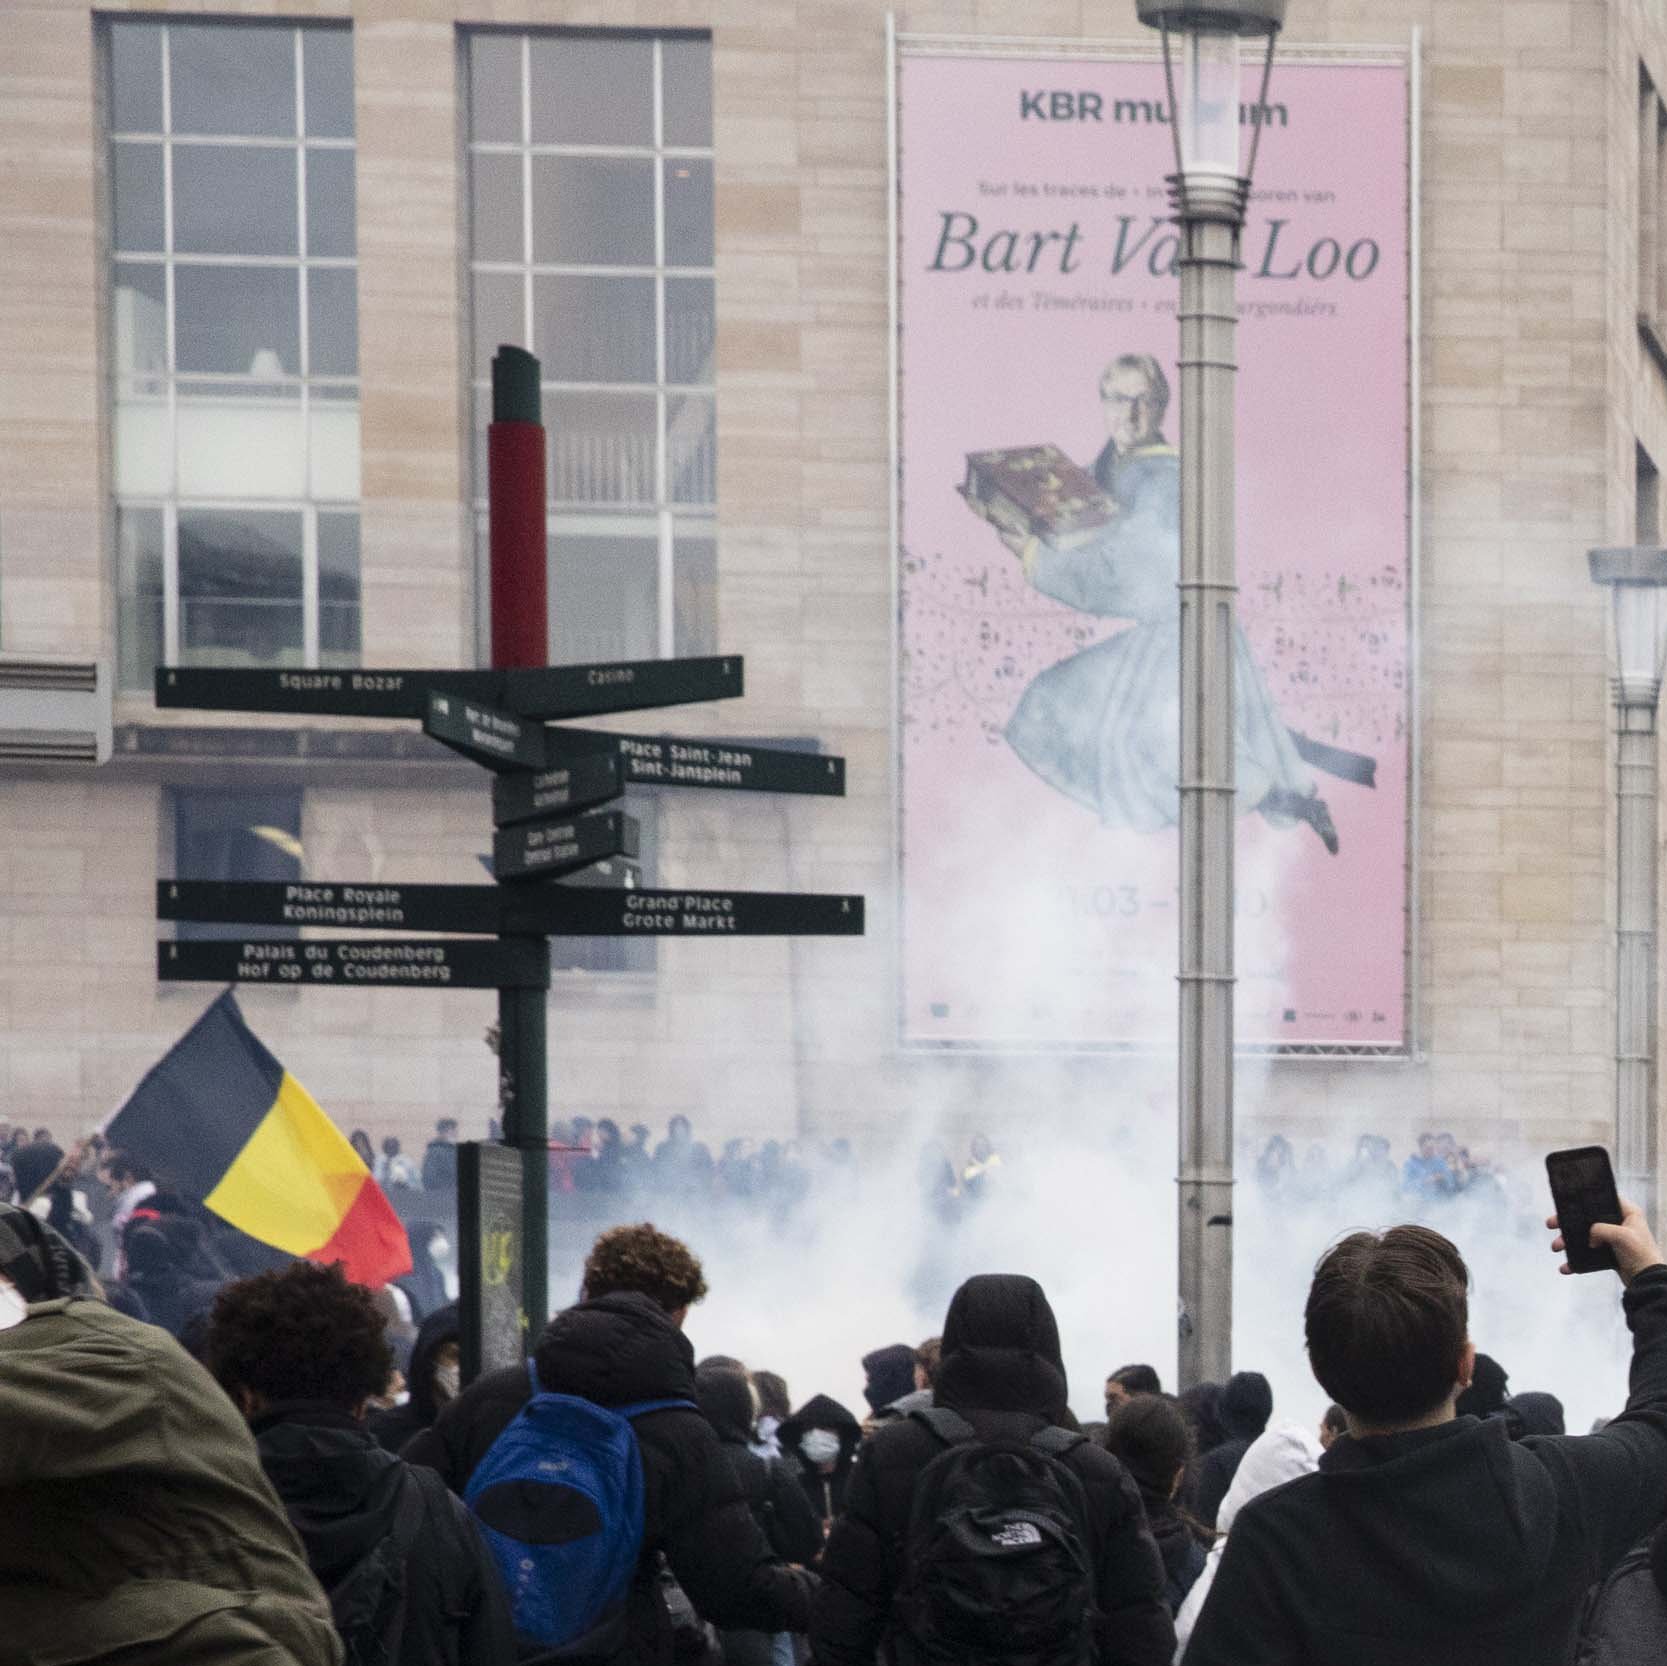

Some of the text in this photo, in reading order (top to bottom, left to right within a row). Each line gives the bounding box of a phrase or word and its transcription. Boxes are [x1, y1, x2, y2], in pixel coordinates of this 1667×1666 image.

[1020, 91, 1288, 127] KBR mum
[926, 210, 1381, 281] Bart Va Loo
[280, 673, 403, 690] Square Bozar
[588, 669, 634, 685] Casino
[619, 739, 752, 767] Place Saint-Jean
[630, 758, 742, 783] Sint-Jansplein
[286, 886, 400, 904] Place Royale
[283, 905, 404, 922] Koningsplein
[623, 912, 736, 929] Grote Markt
[243, 944, 445, 964] Palais du Coudenberg
[237, 961, 450, 981] Hof op de Coudenberg
